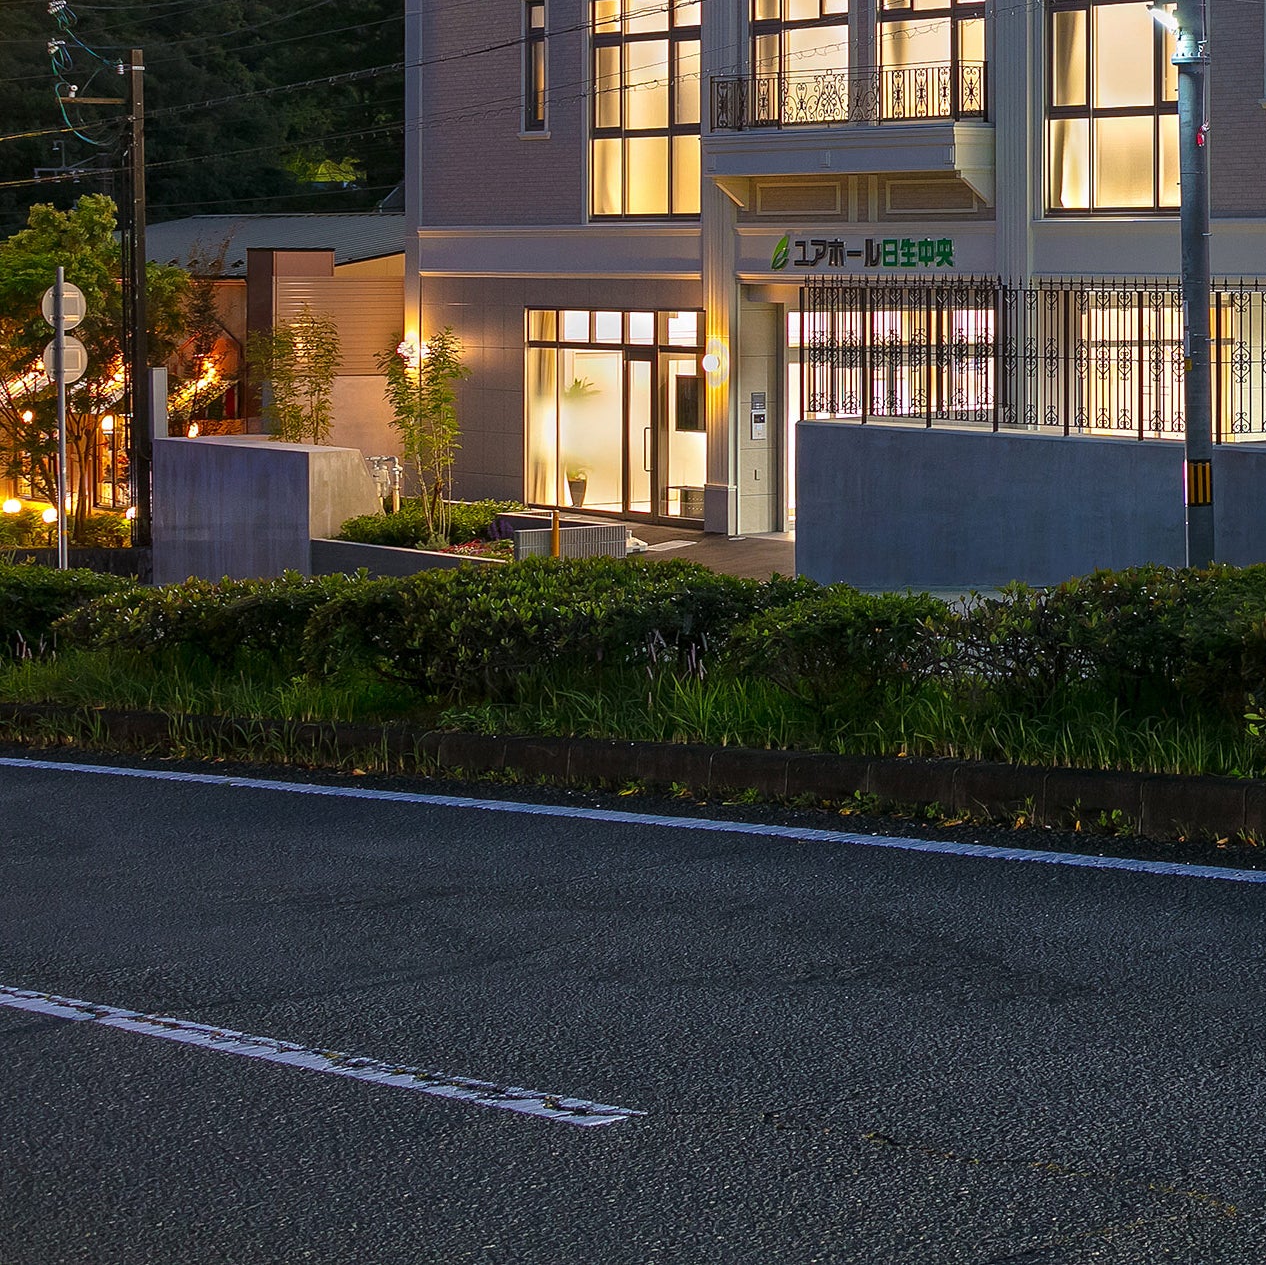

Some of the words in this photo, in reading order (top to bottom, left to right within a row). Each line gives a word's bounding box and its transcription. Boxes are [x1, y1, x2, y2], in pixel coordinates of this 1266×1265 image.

[794, 237, 955, 268] ユアホール日生中央
